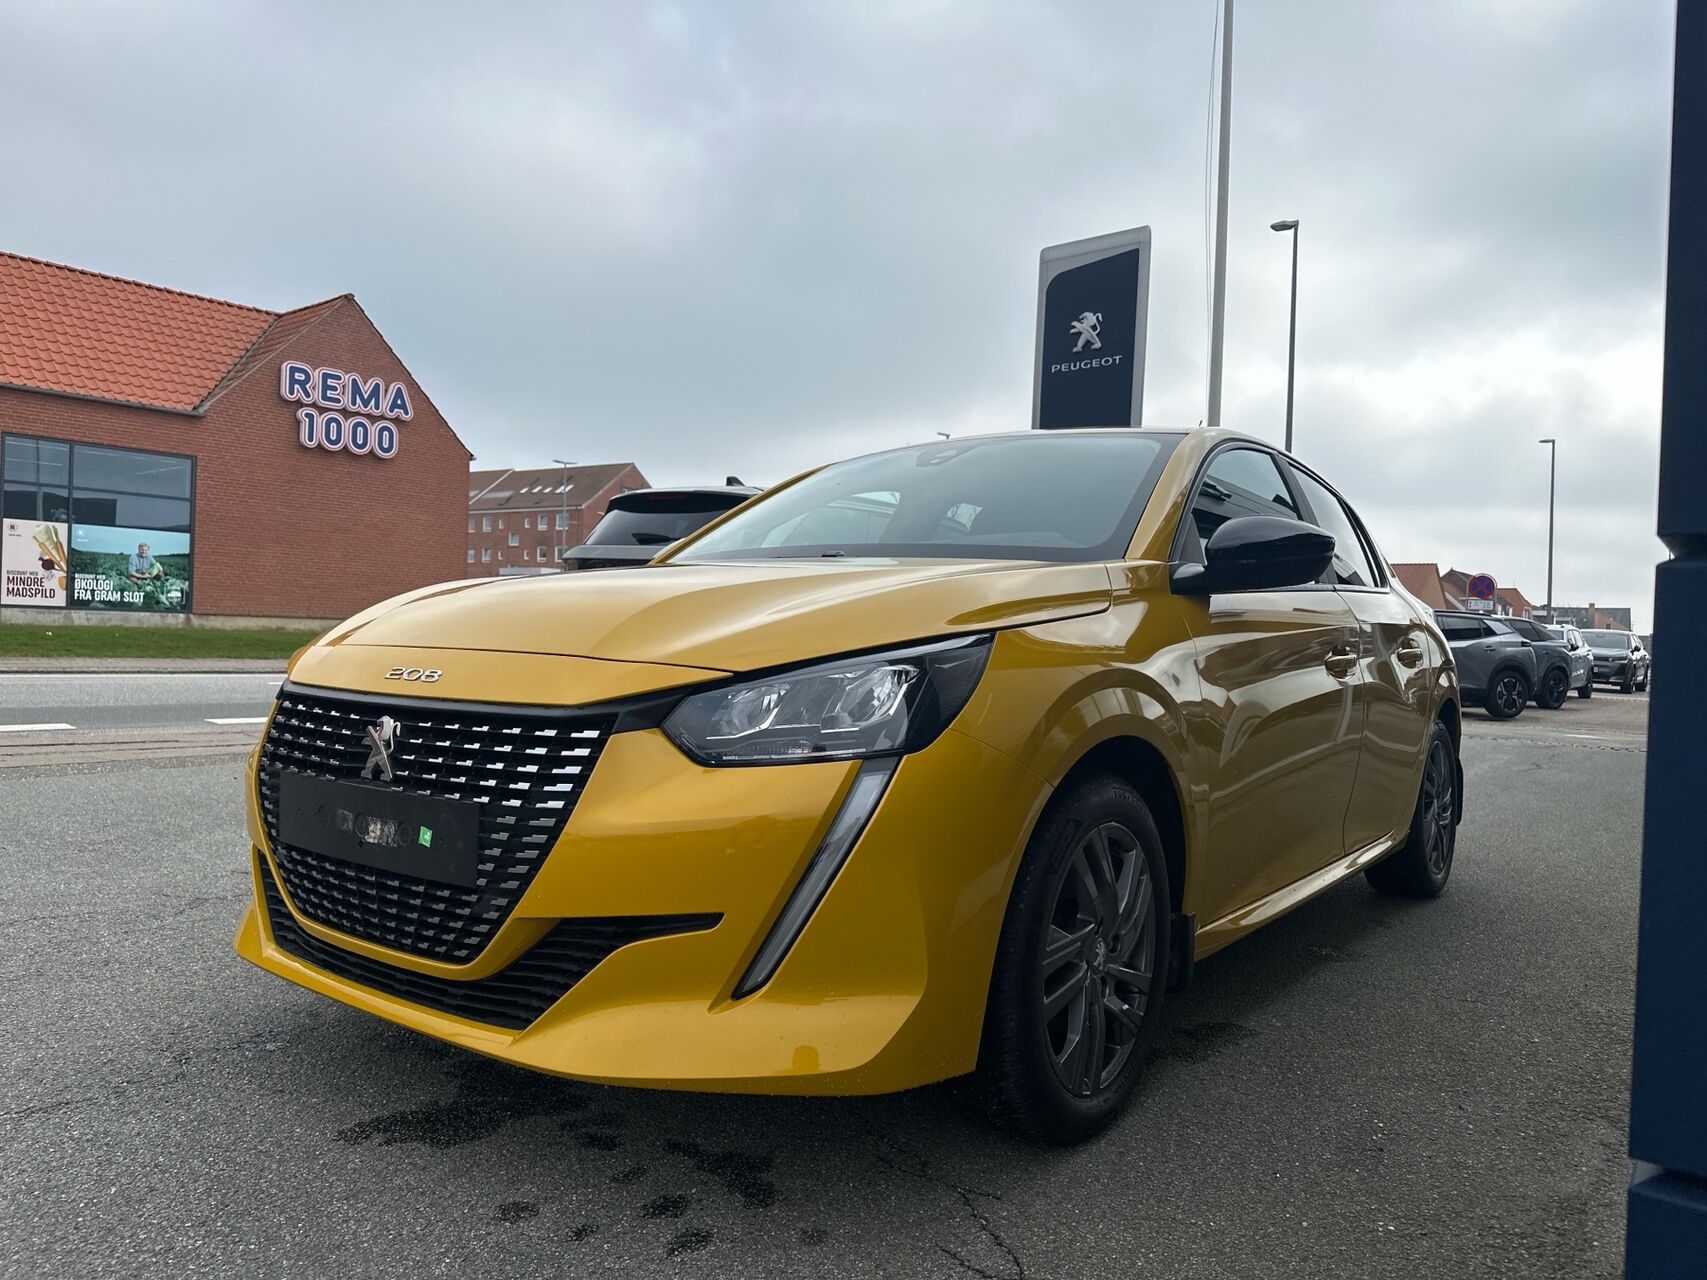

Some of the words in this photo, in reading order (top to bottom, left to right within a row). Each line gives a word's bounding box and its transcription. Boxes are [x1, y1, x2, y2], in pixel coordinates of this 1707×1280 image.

[1051, 355, 1123, 374] PEUGEOT
[280, 360, 413, 421] REMA
[296, 407, 399, 459] 1000
[6, 575, 45, 587] MINDRE
[74, 578, 114, 591] ØKOLOGI
[6, 586, 56, 599] MADSPILD
[74, 590, 92, 600] FRA
[94, 590, 121, 602] GRAM
[123, 591, 145, 603] SLOT
[384, 666, 443, 683] 208
